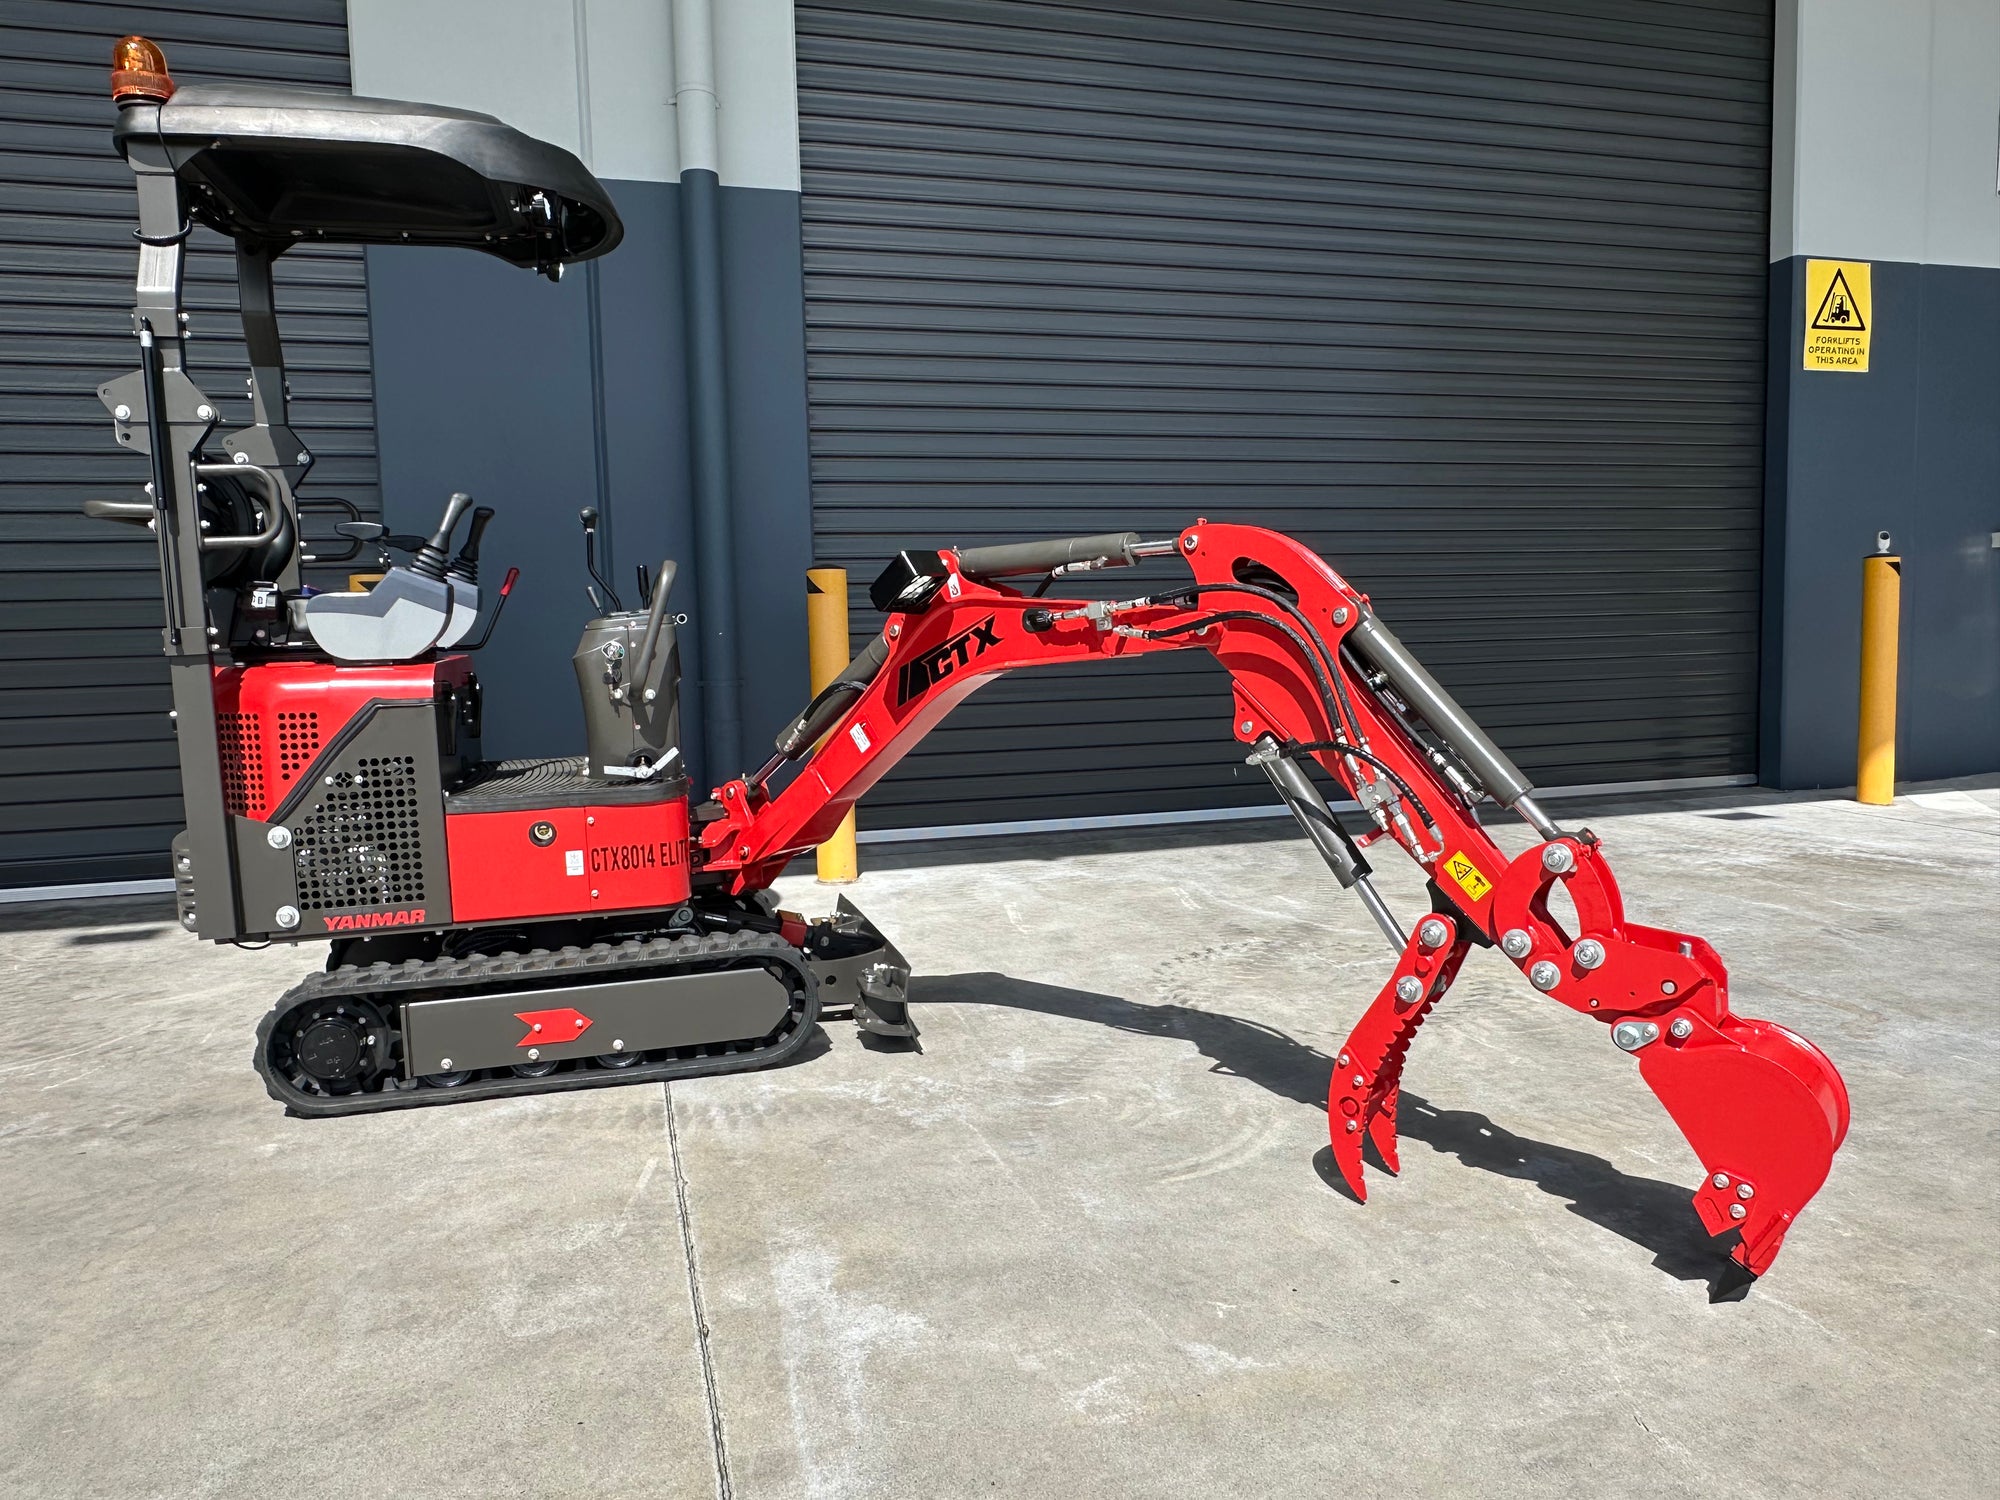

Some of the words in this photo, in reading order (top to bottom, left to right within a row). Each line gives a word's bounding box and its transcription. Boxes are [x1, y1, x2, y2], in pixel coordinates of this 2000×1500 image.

[1815, 336, 1861, 346] FORKLIFTS
[1808, 346, 1855, 355] OPERATING
[1856, 347, 1865, 355] IN
[1816, 356, 1834, 364] THIS
[1835, 357, 1858, 365] AREA
[922, 615, 1005, 686] CTX
[591, 843, 655, 872] CTX8014
[323, 909, 426, 932] YANMAR
